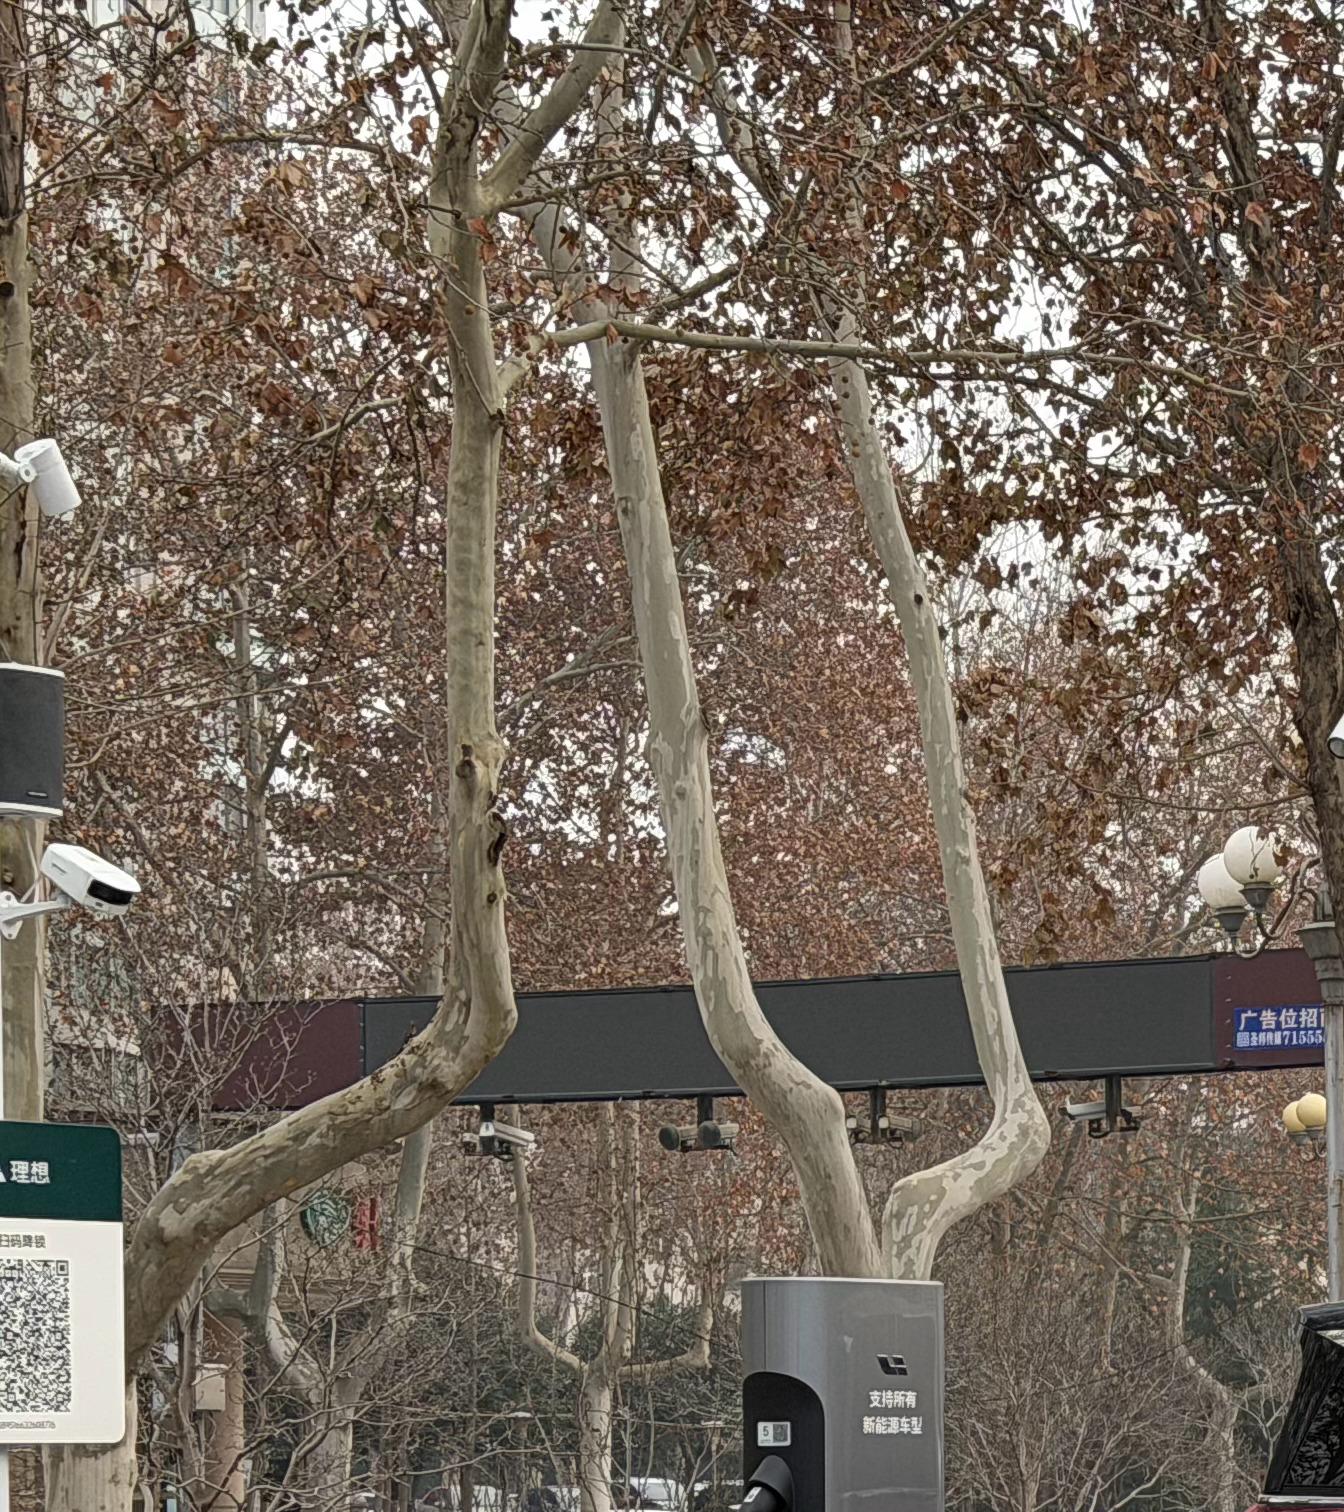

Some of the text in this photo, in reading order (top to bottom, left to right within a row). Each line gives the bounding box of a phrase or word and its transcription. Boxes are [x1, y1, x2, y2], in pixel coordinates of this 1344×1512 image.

[1282, 1030, 1326, 1046] 71555
[9, 1160, 50, 1184] 理想
[868, 1389, 918, 1408] 支持所有
[863, 1415, 922, 1435] 新能源车型
